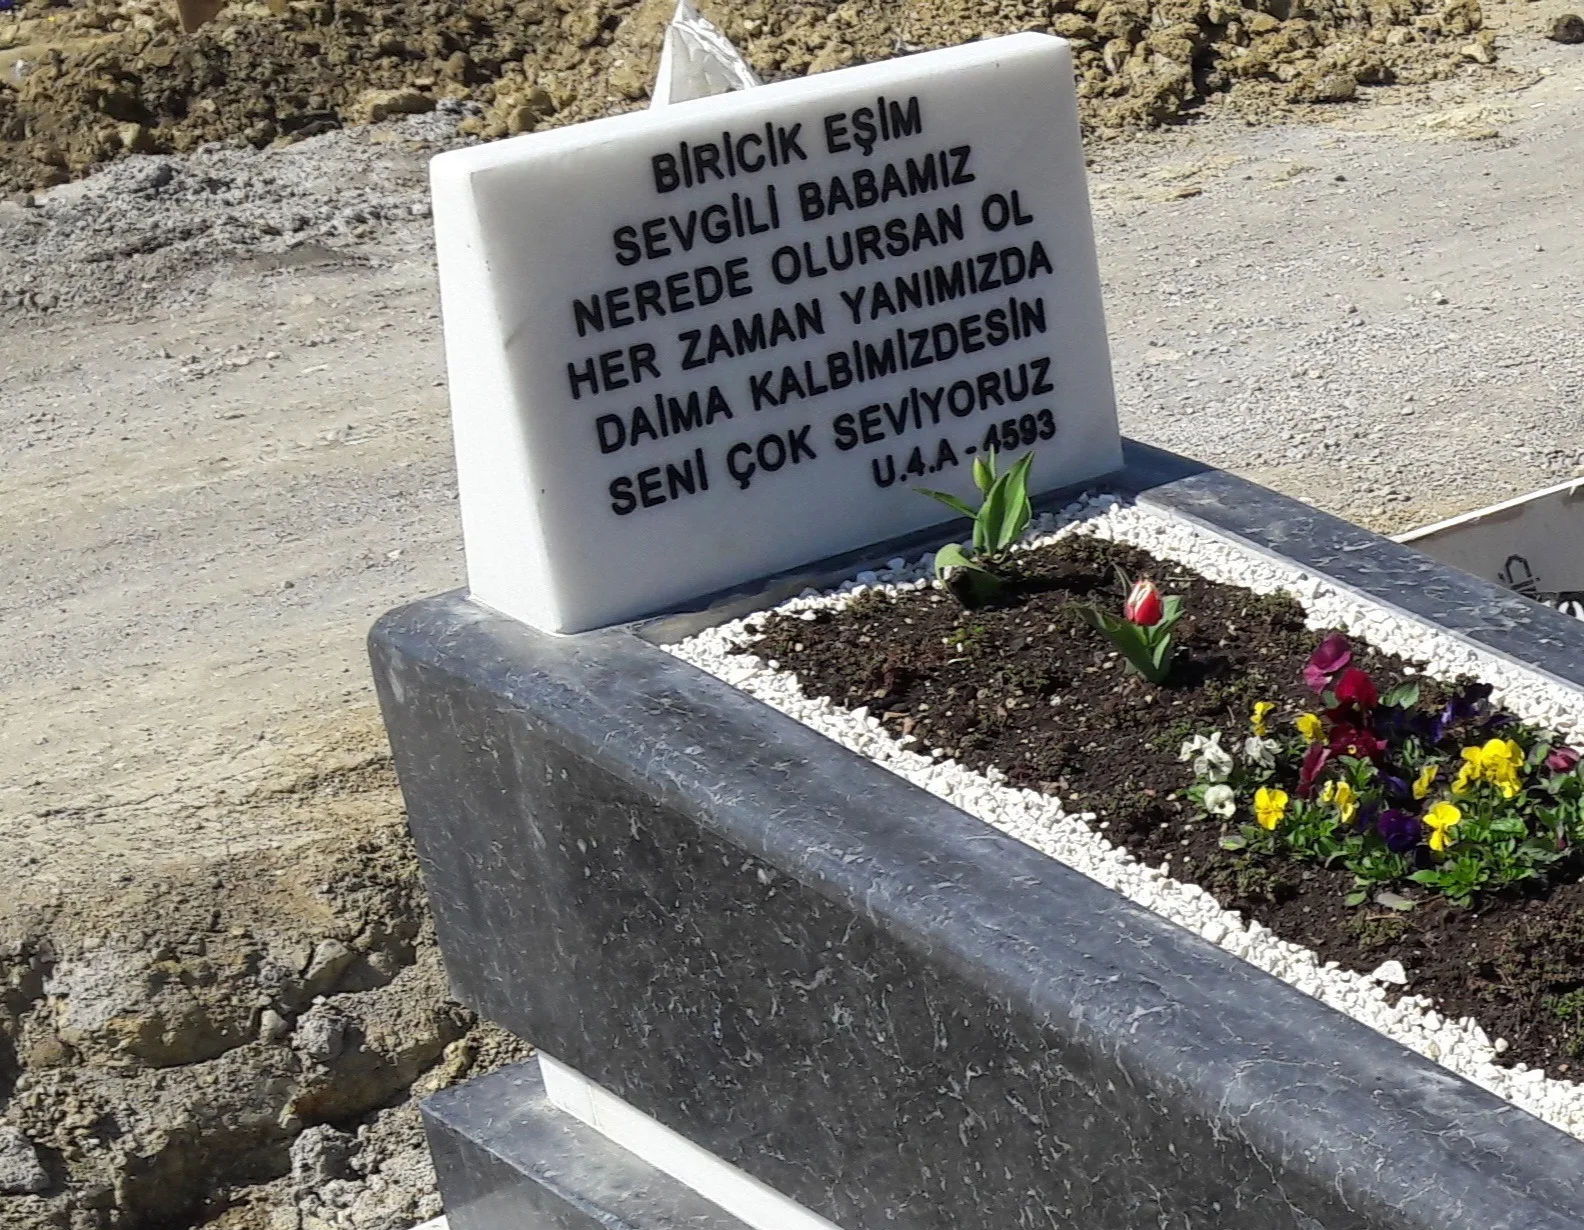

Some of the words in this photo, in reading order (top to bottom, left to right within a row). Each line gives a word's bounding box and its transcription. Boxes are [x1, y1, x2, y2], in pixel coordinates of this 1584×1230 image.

[612, 184, 781, 267] SEVGİLİ
[797, 144, 976, 223] BABAMIZ
[651, 121, 808, 195] BİRİCİK
[823, 96, 923, 157] EŞİM
[566, 342, 662, 401] HER
[677, 297, 826, 372] ZAMAN
[840, 240, 1054, 326] YANIMIZDA
[572, 256, 754, 338] NEREDE
[770, 203, 965, 286] OLURSAN
[980, 189, 1034, 233] OL
[594, 385, 735, 455] DAİMA
[748, 296, 1048, 412] KALBİMİZDESİN
[607, 447, 710, 517] SENİ
[725, 423, 818, 491] ÇOK
[831, 356, 1056, 453] SEVİYORUZ
